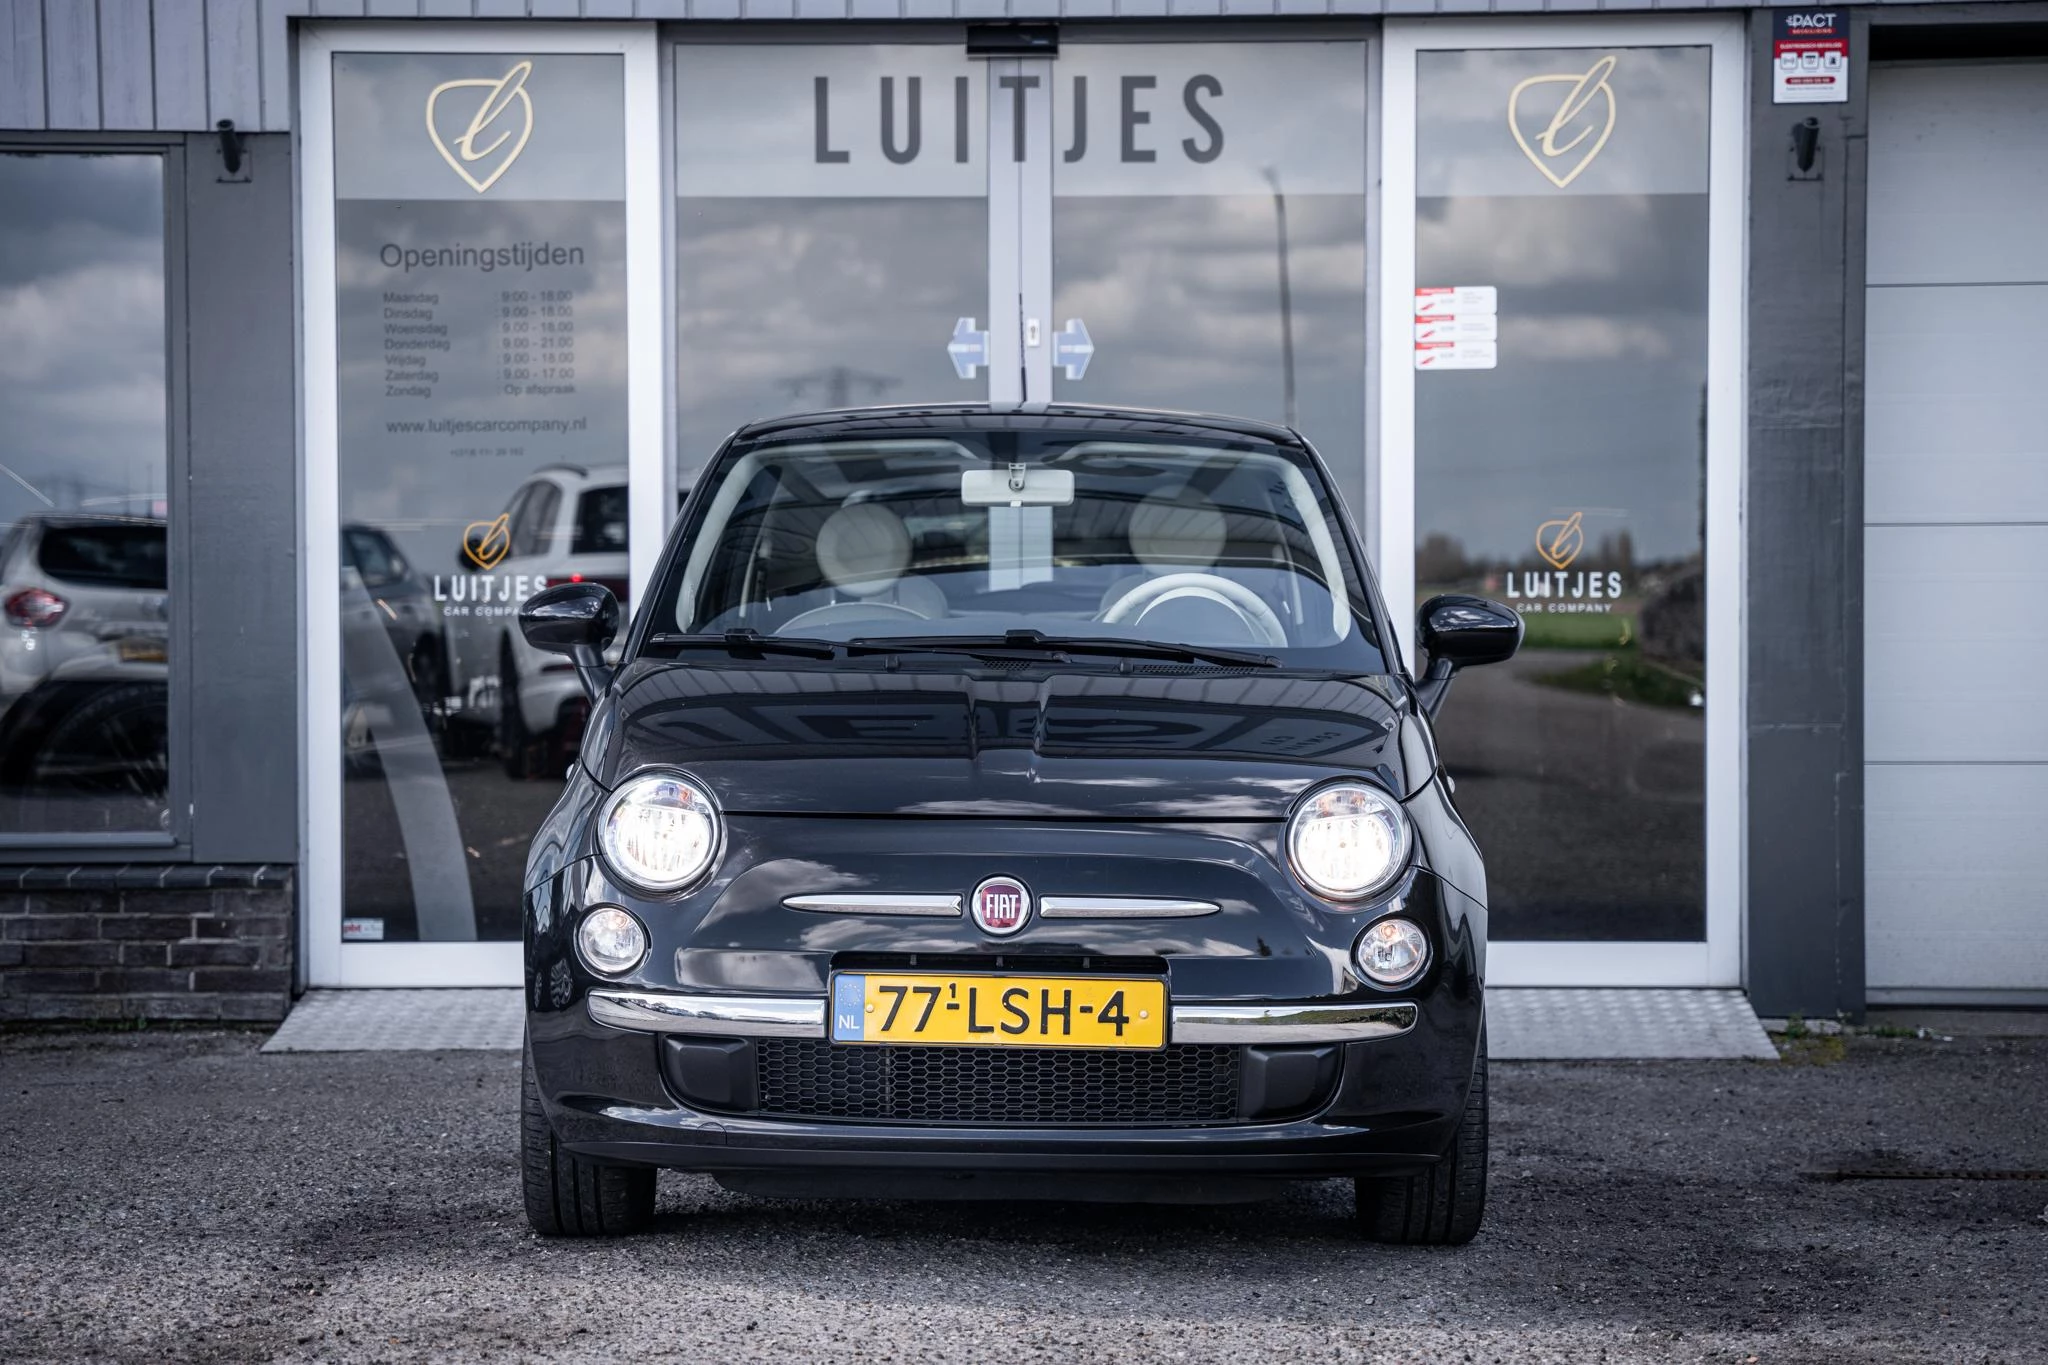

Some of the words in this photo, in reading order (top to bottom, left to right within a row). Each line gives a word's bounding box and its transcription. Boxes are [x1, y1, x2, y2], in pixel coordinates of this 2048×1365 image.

[814, 74, 1225, 165] LUITJES
[380, 242, 585, 273] Openingstijden
[386, 417, 587, 436] www.luitjescarcompany.nl
[1506, 571, 1622, 599] LUITJES
[443, 606, 470, 617] CAR
[475, 606, 519, 617] COMPA
[1516, 603, 1543, 614] CAR
[1548, 602, 1613, 614] COMPANY
[986, 893, 1020, 919] FIAT
[838, 1014, 860, 1031] NL
